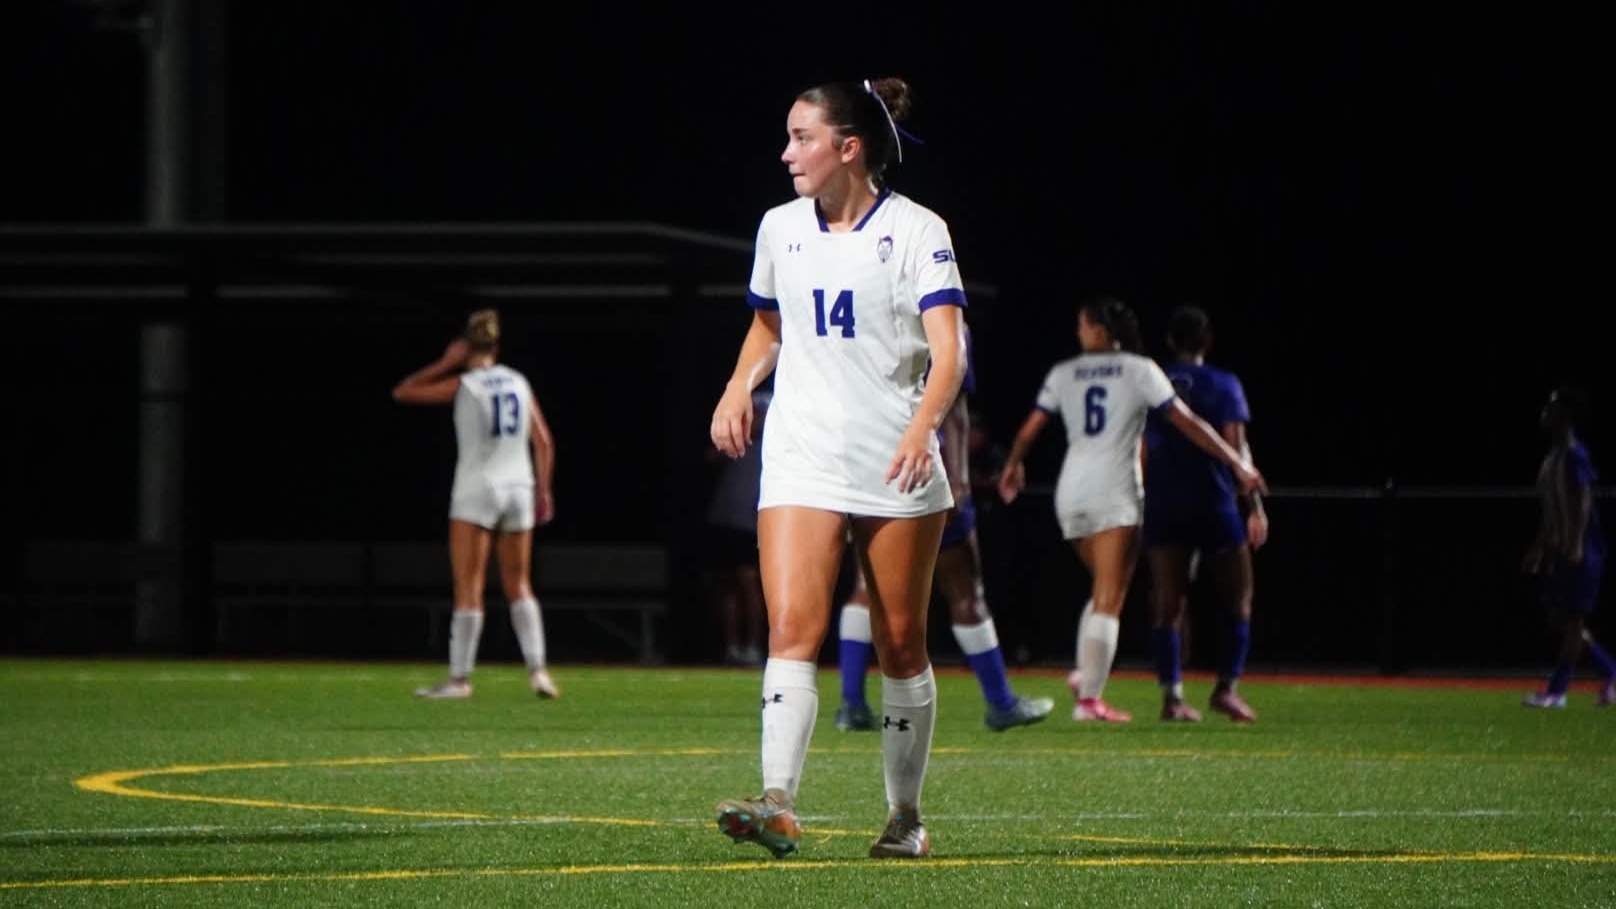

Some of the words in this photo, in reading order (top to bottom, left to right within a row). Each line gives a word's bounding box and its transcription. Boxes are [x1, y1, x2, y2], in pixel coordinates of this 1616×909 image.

[812, 289, 855, 338] 14
[491, 393, 519, 437] 13
[1085, 385, 1107, 437] 6
